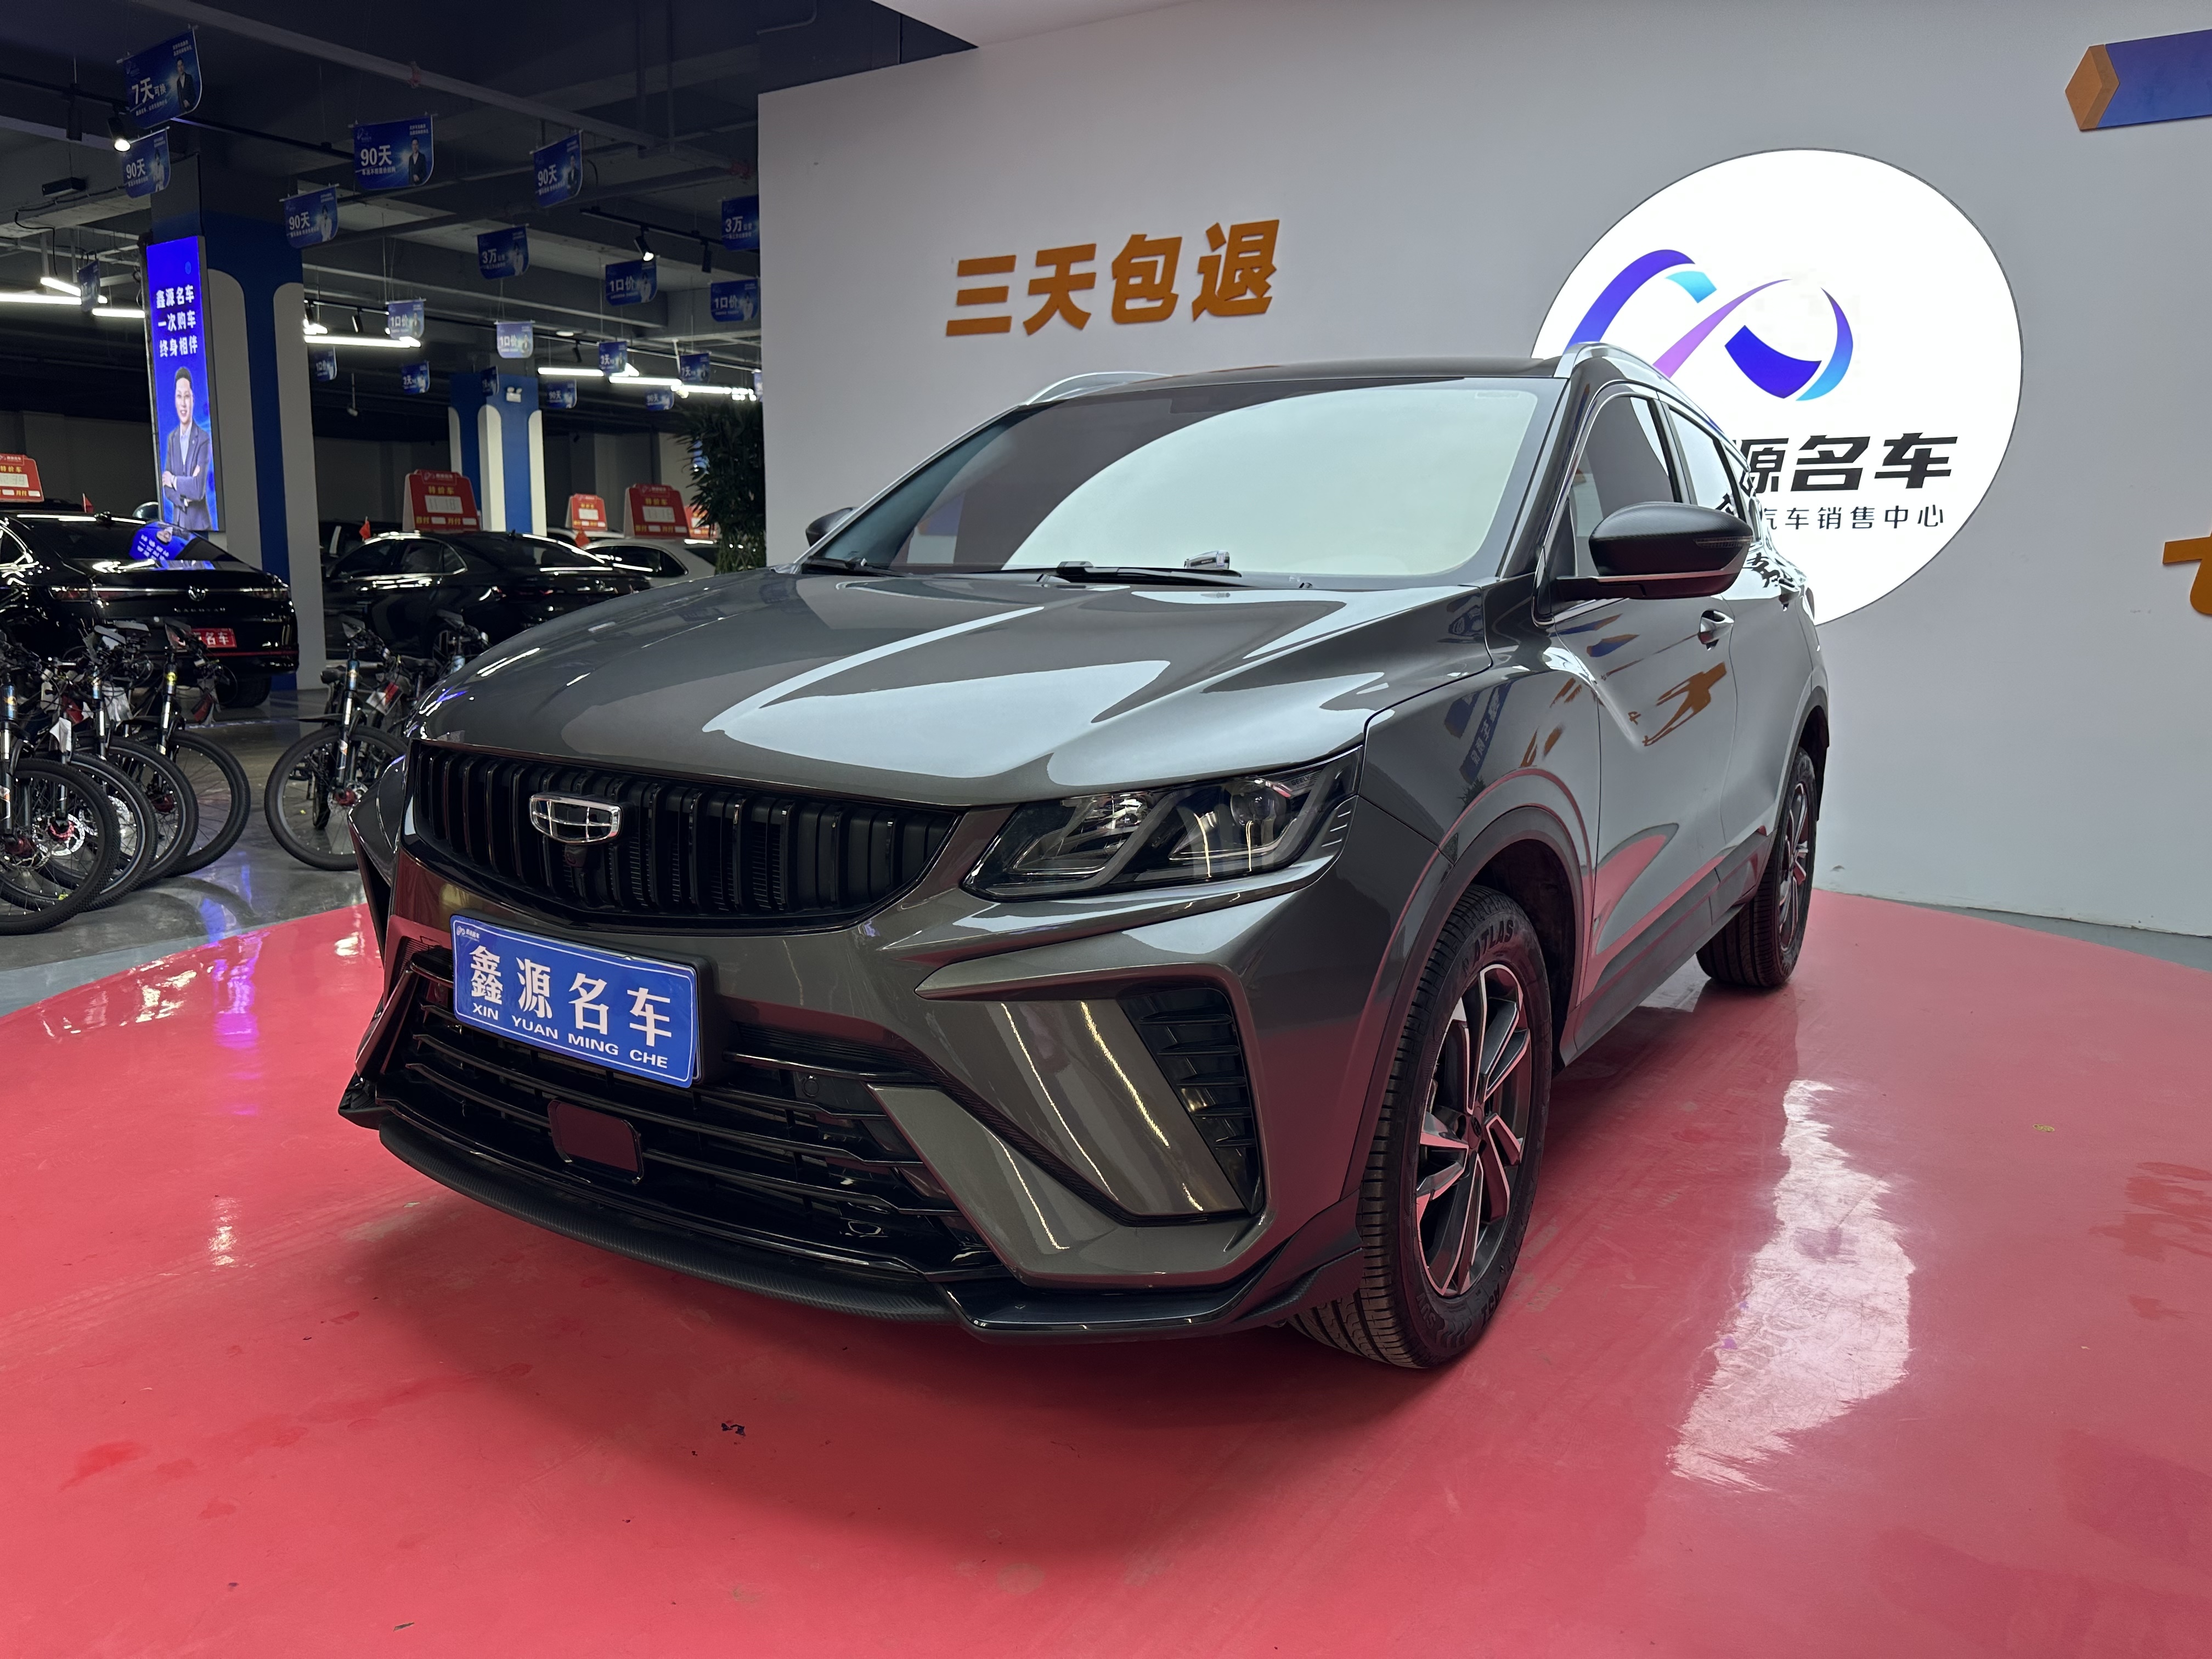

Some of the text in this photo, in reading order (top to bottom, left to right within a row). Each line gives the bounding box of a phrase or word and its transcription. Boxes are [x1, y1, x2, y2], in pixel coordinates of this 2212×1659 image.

[360, 145, 392, 167] 90天
[126, 157, 146, 179] 90天
[538, 164, 557, 187] 90天
[289, 211, 311, 230] 90天
[610, 275, 635, 292] 1口价
[946, 219, 1280, 336] 三天包退
[156, 284, 195, 309] 鑫源名车
[714, 295, 738, 309] 1口价
[157, 310, 196, 332] 一次购车
[390, 314, 409, 328] 1口价
[159, 335, 198, 358] 终身相伴
[499, 334, 518, 347] 1口价
[1291, 775, 1310, 786] GEELY
[1473, 919, 1514, 968] ATLAS
[469, 945, 673, 1048] 鑫源名车
[472, 1002, 668, 1069] XIN YUAN MING CHE
[1416, 1292, 1437, 1330] SUV
